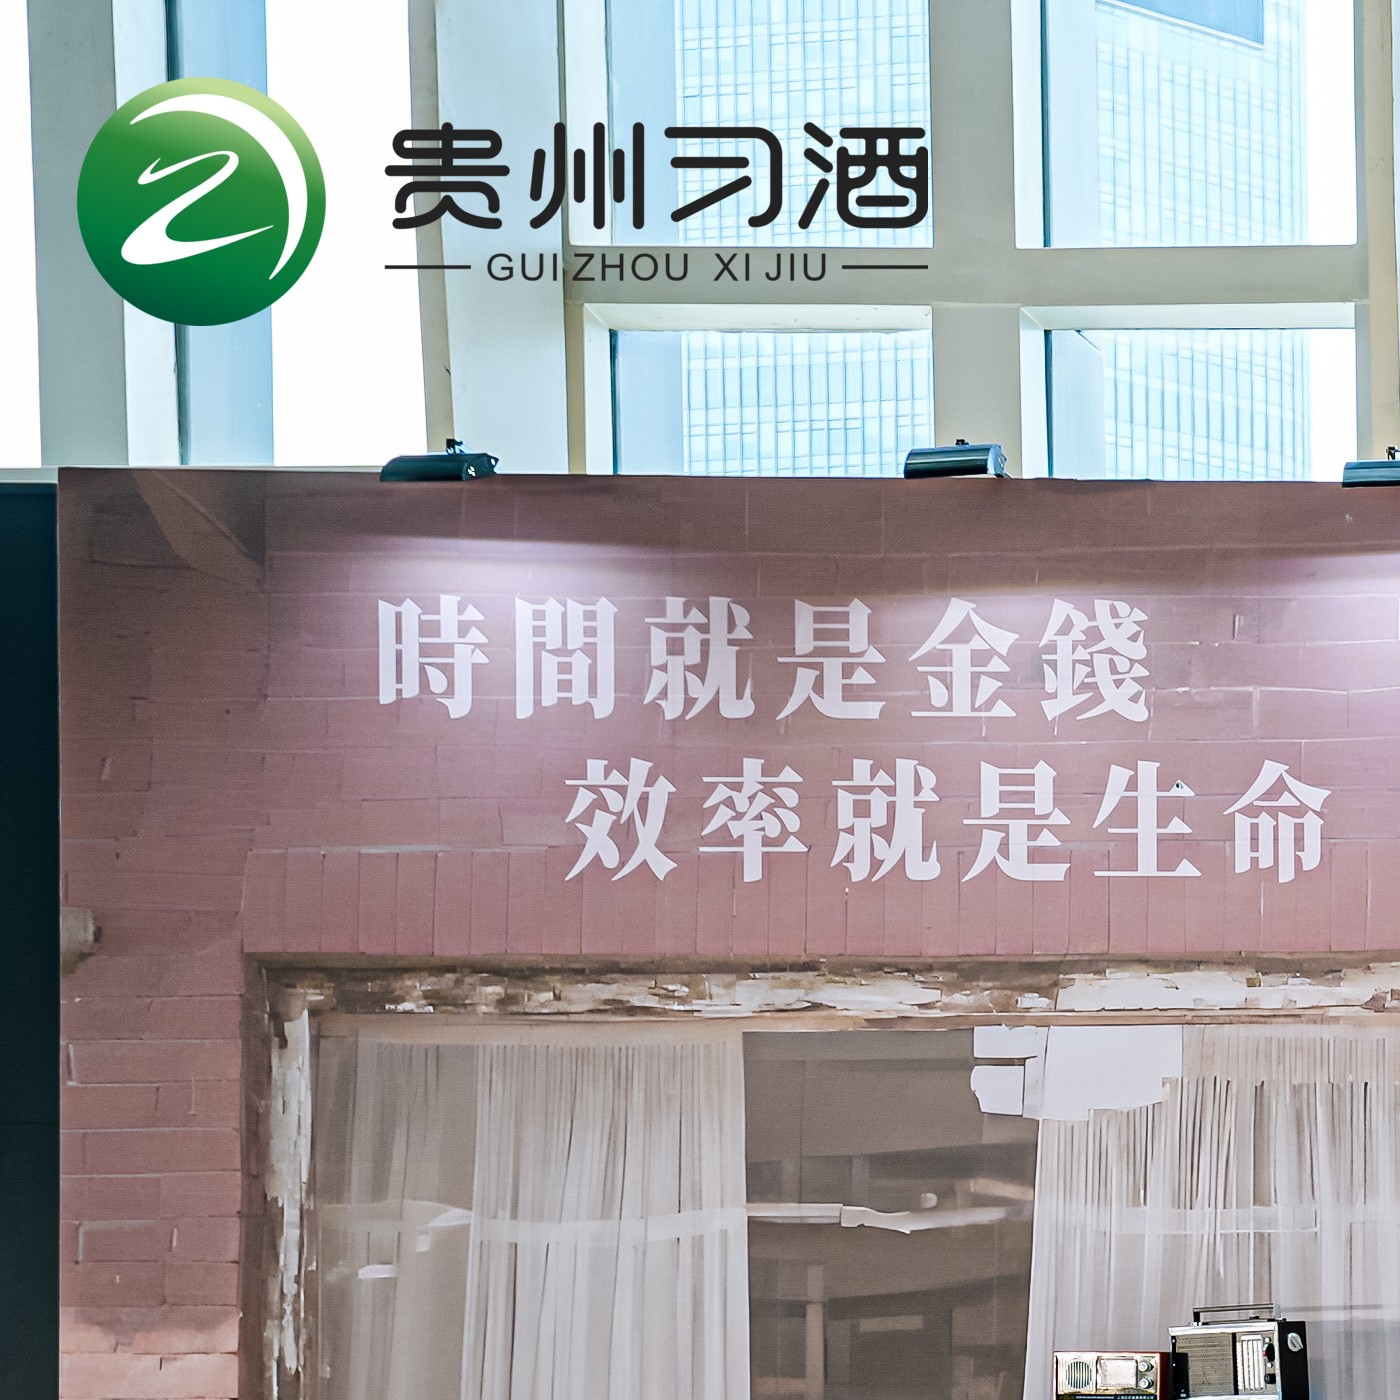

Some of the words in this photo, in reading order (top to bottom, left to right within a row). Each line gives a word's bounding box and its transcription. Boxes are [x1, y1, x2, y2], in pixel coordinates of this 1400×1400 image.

[376, 597, 1152, 723] 時間就是金錢
[564, 758, 1333, 886] 效率就是生命
